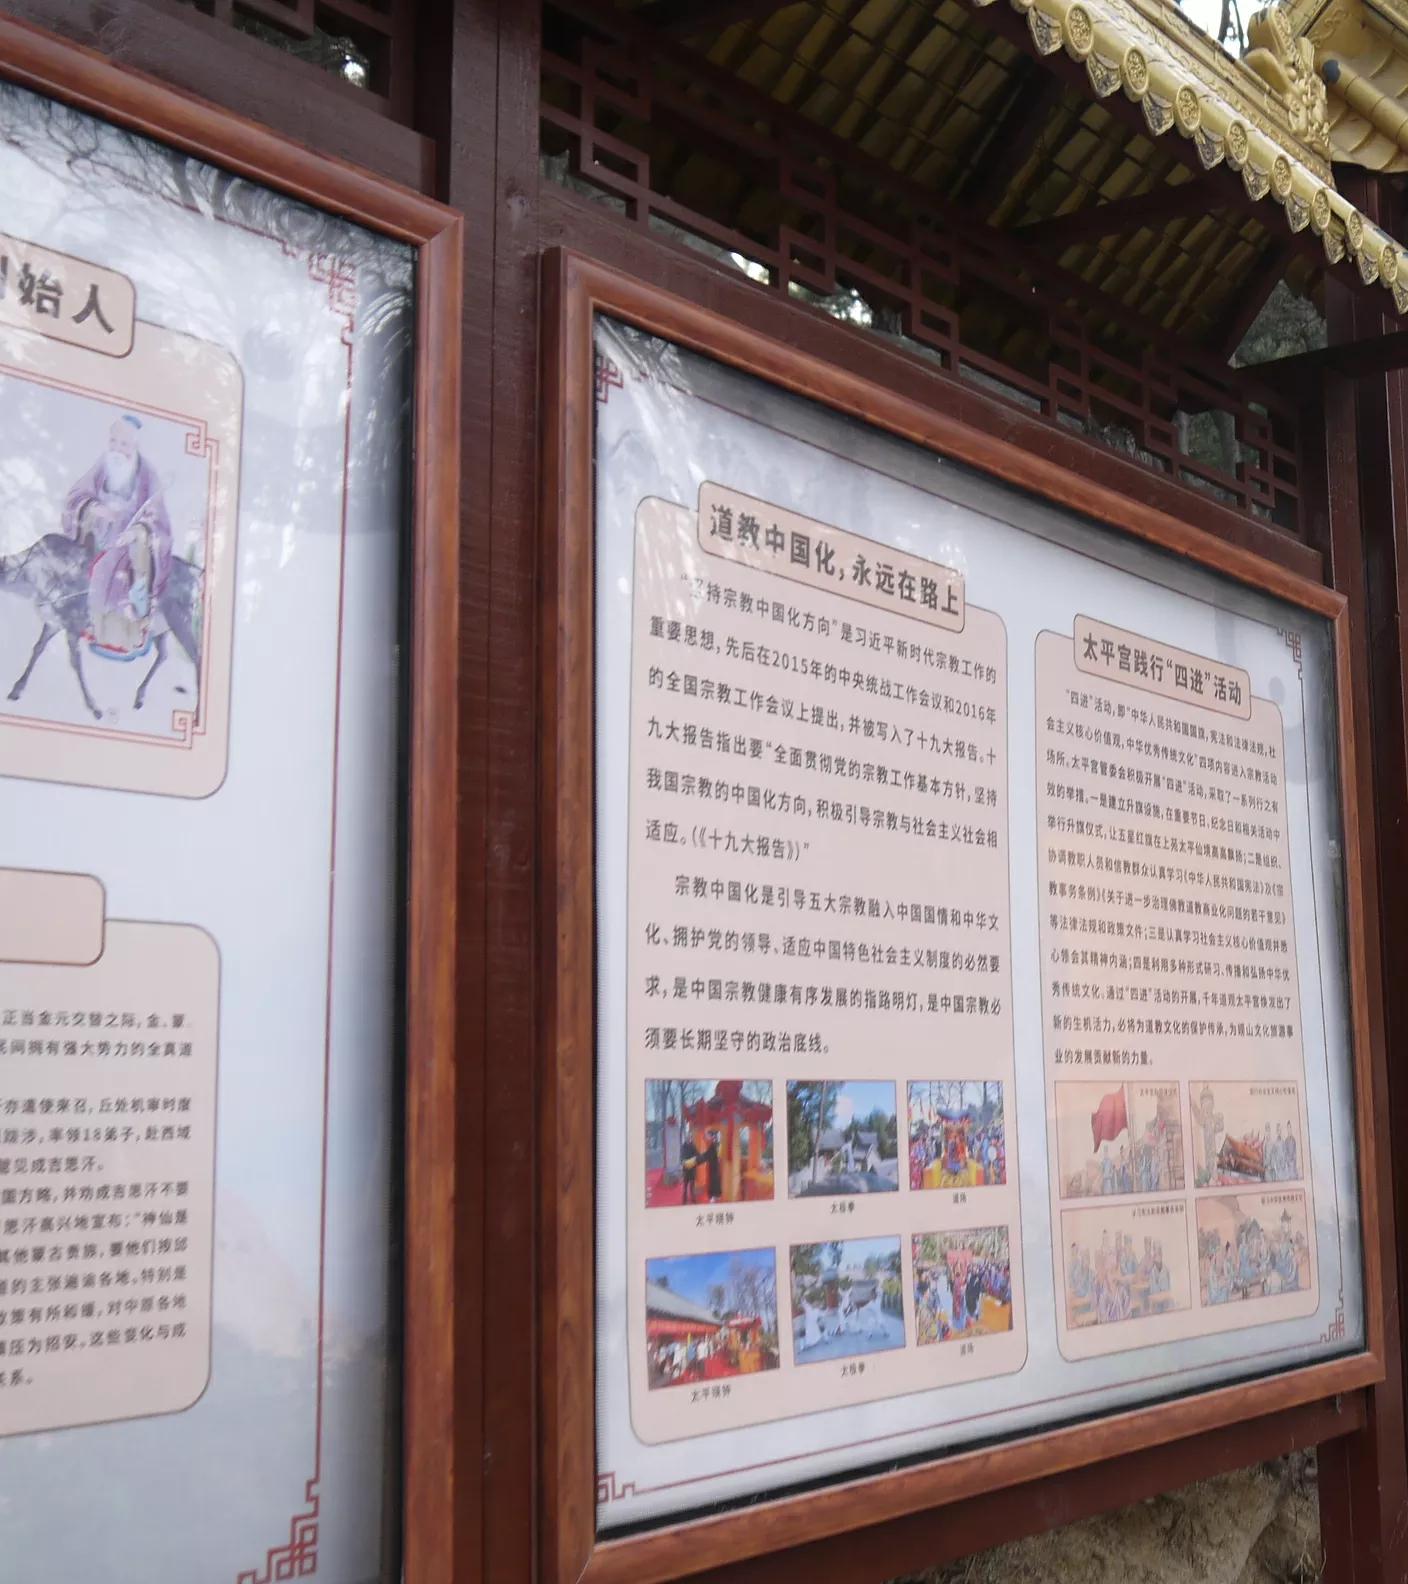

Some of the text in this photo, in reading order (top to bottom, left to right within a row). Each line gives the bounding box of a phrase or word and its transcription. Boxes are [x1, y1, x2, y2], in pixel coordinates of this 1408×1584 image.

[0, 255, 115, 334] 始人
[1083, 632, 1242, 706] 太平宫践行“四进”活动
